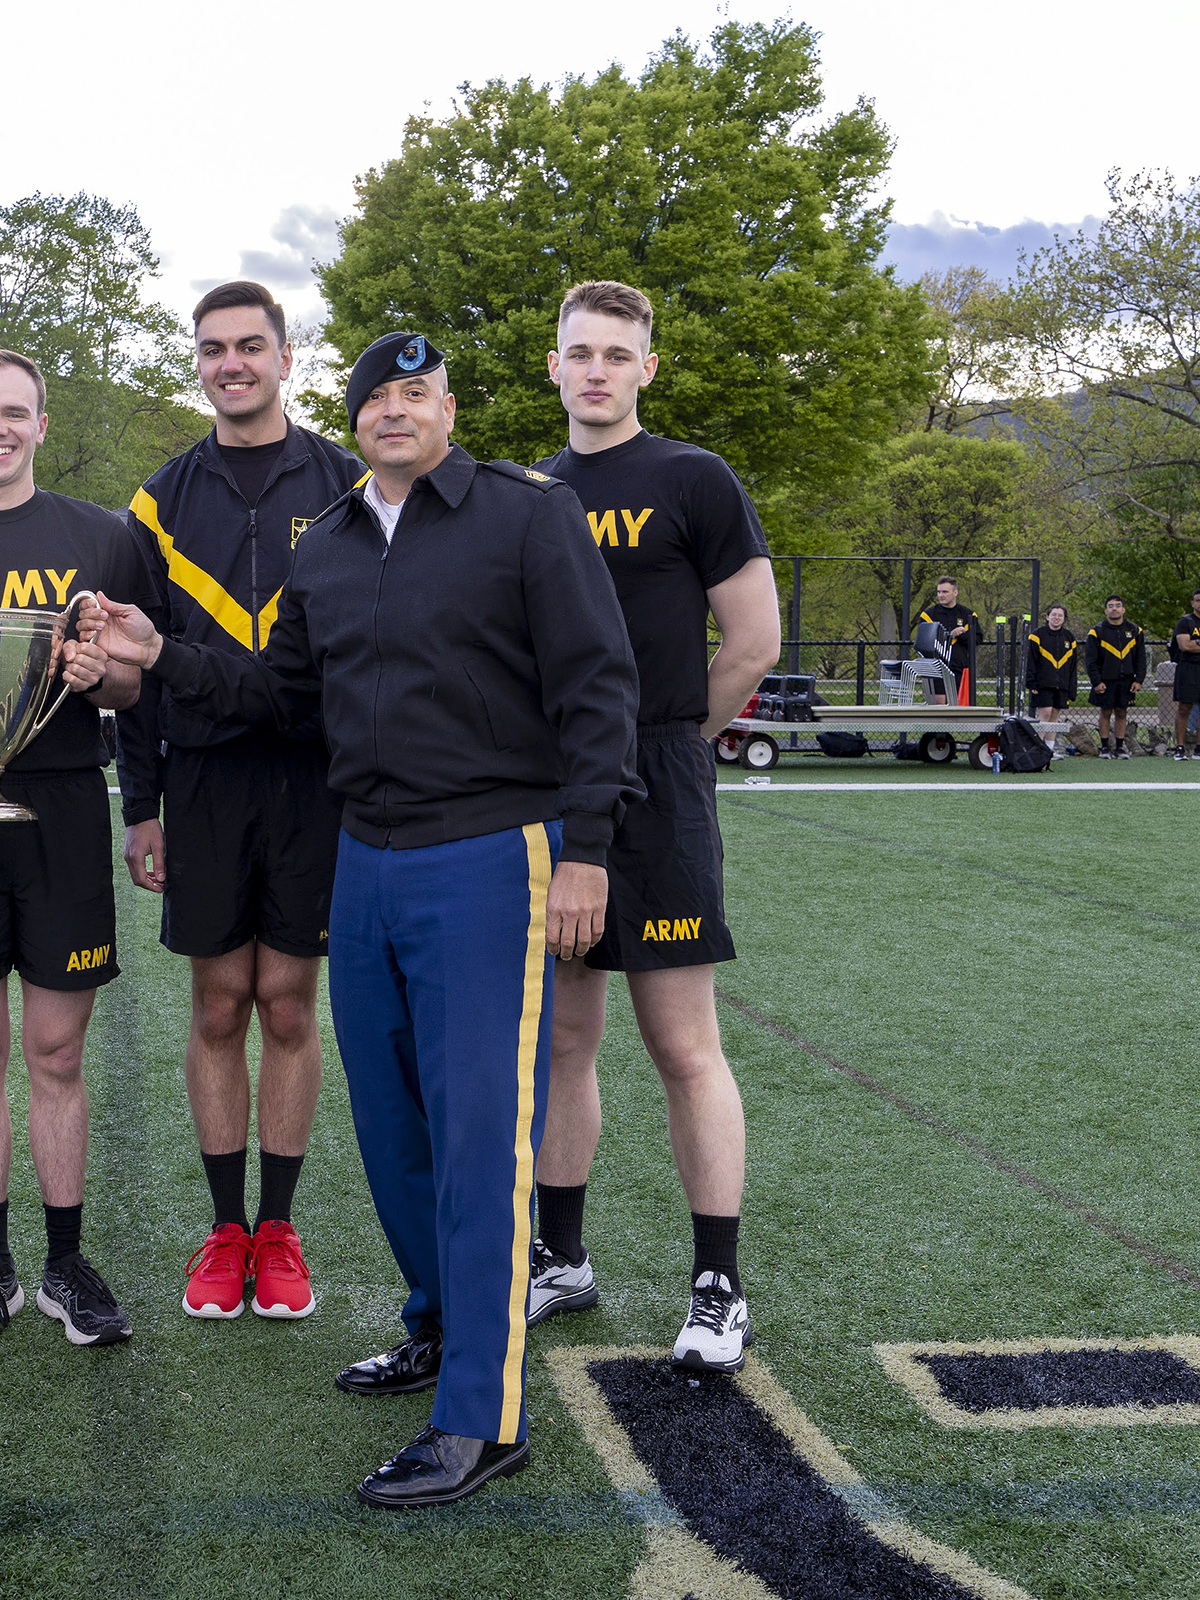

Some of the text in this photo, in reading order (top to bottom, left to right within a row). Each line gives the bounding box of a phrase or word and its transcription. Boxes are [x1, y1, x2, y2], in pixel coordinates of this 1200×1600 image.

[586, 508, 654, 548] MY
[642, 917, 702, 941] ARMY
[66, 944, 110, 972] ARMY
